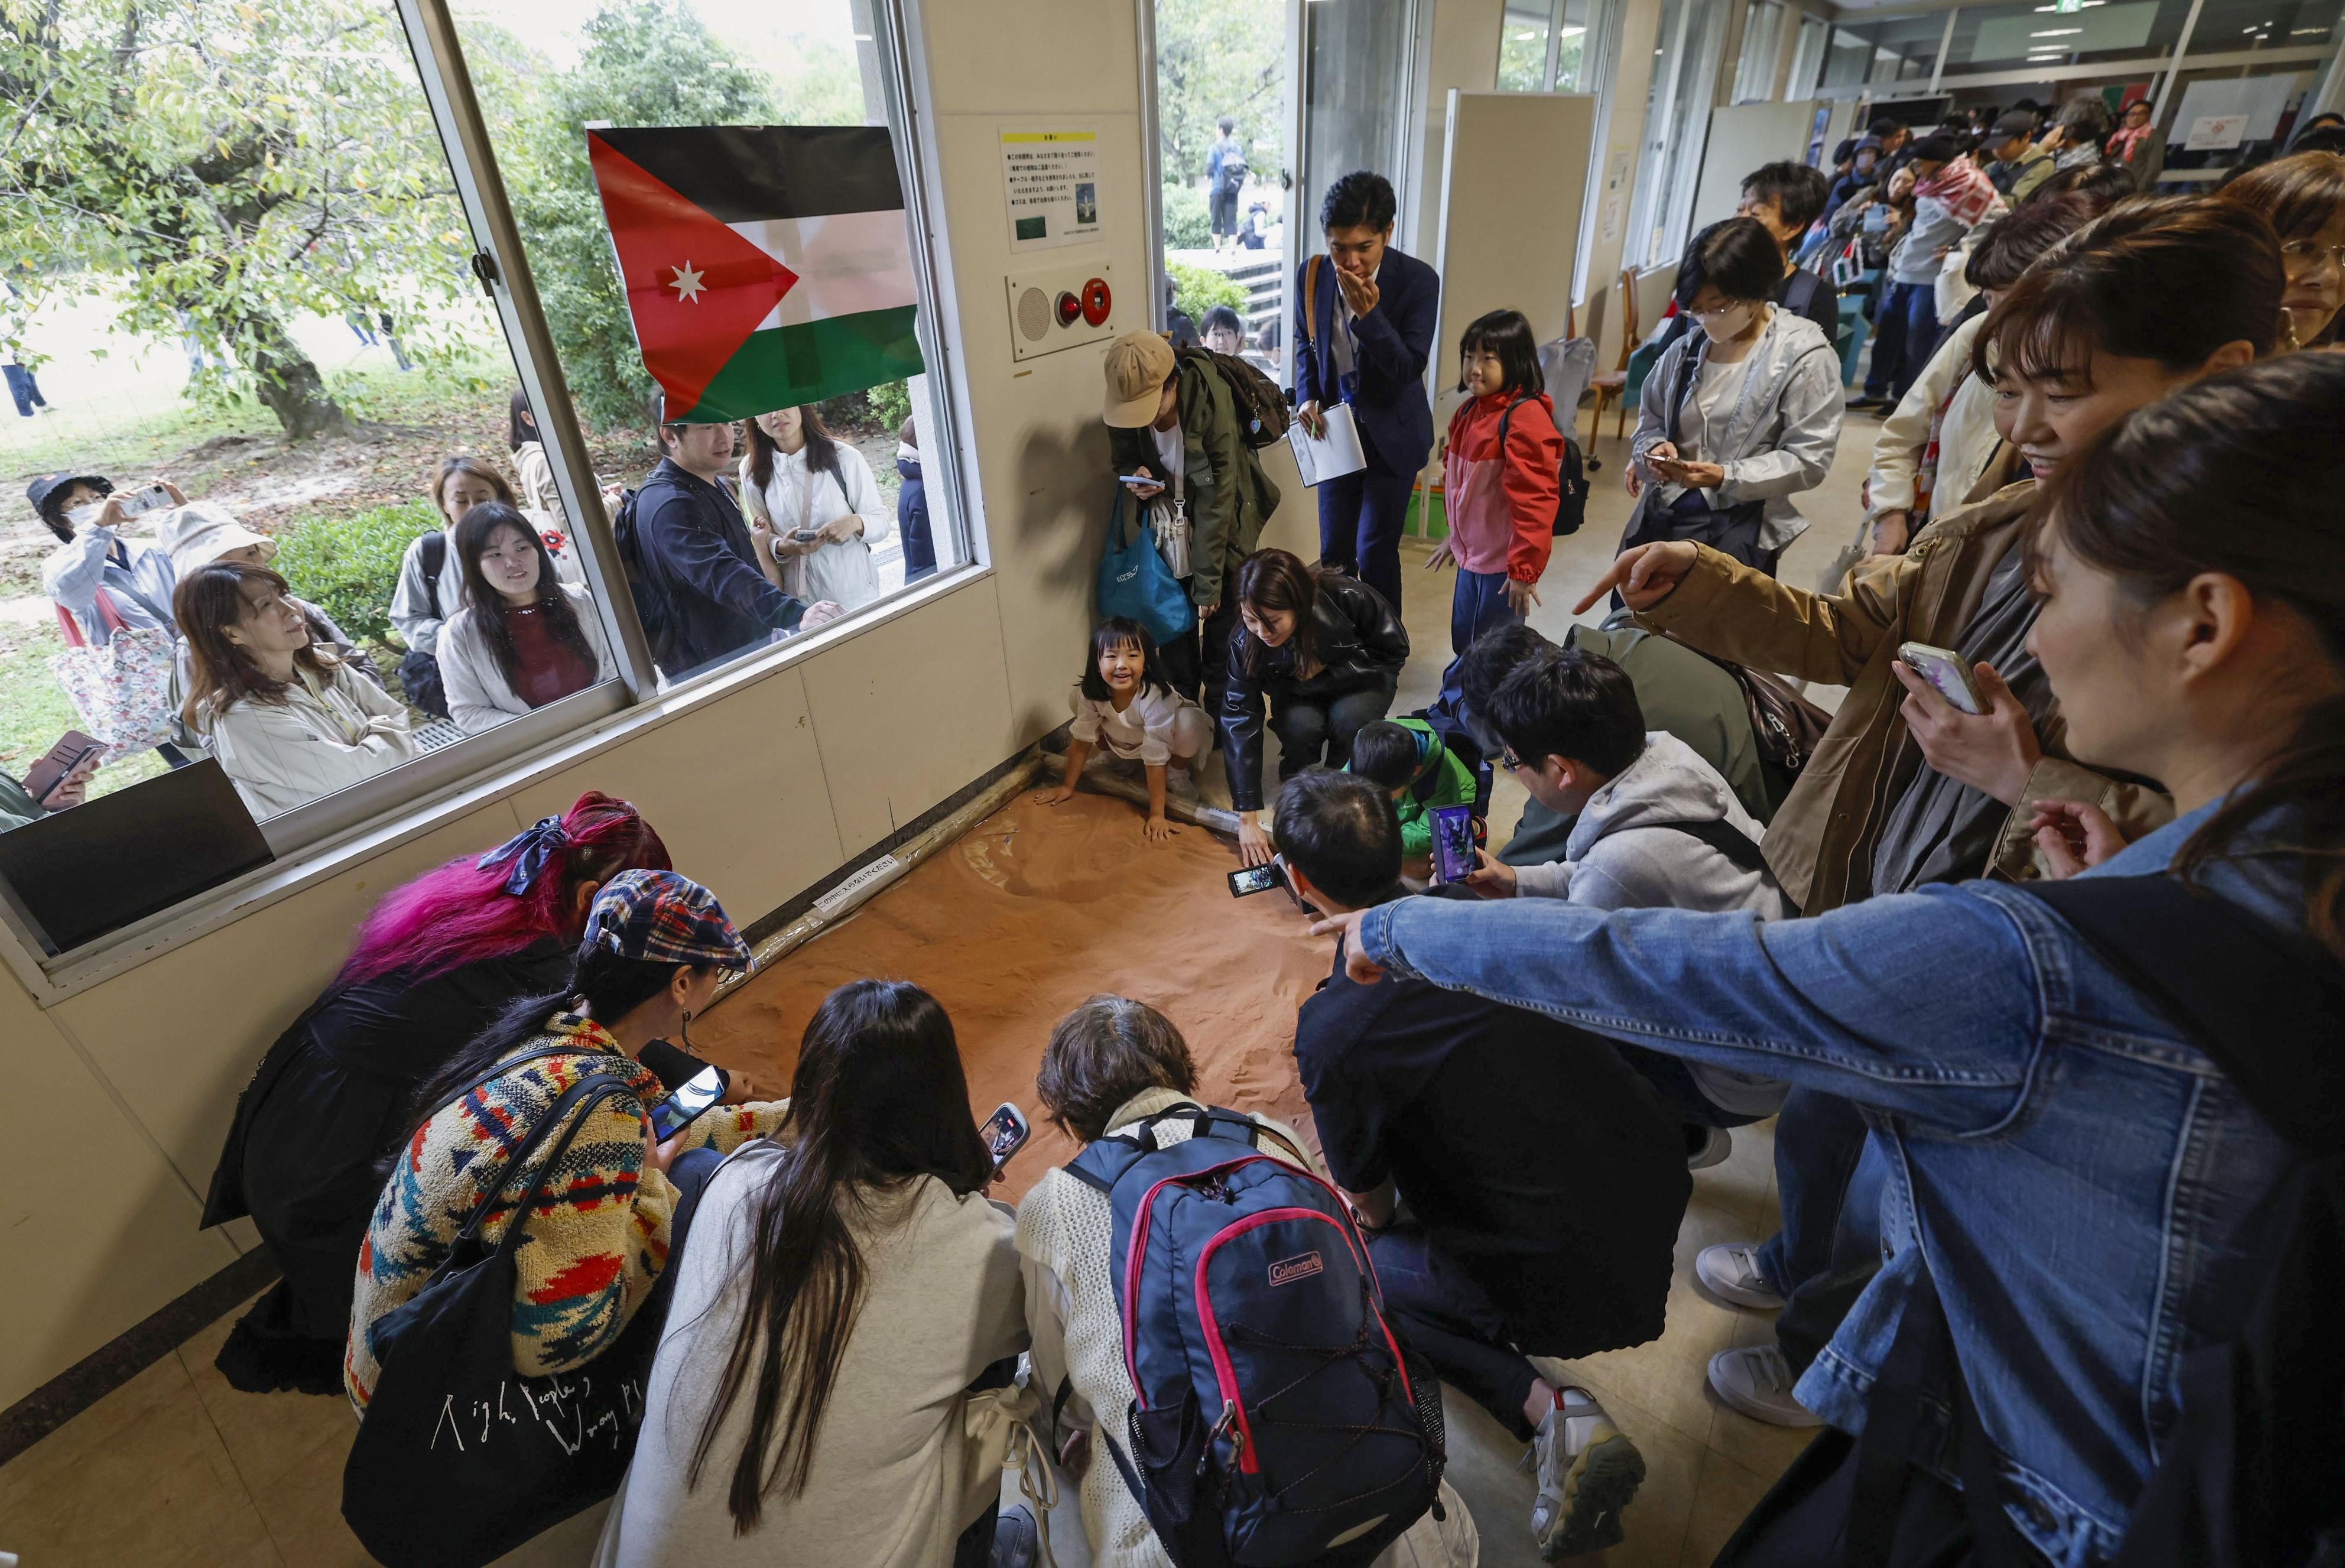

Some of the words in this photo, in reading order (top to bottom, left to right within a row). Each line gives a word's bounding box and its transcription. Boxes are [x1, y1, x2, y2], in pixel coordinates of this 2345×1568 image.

[818, 858, 894, 908] この中に入らないでください
[1273, 1261, 1313, 1279] Coleman
[431, 1381, 517, 1452] Righ
